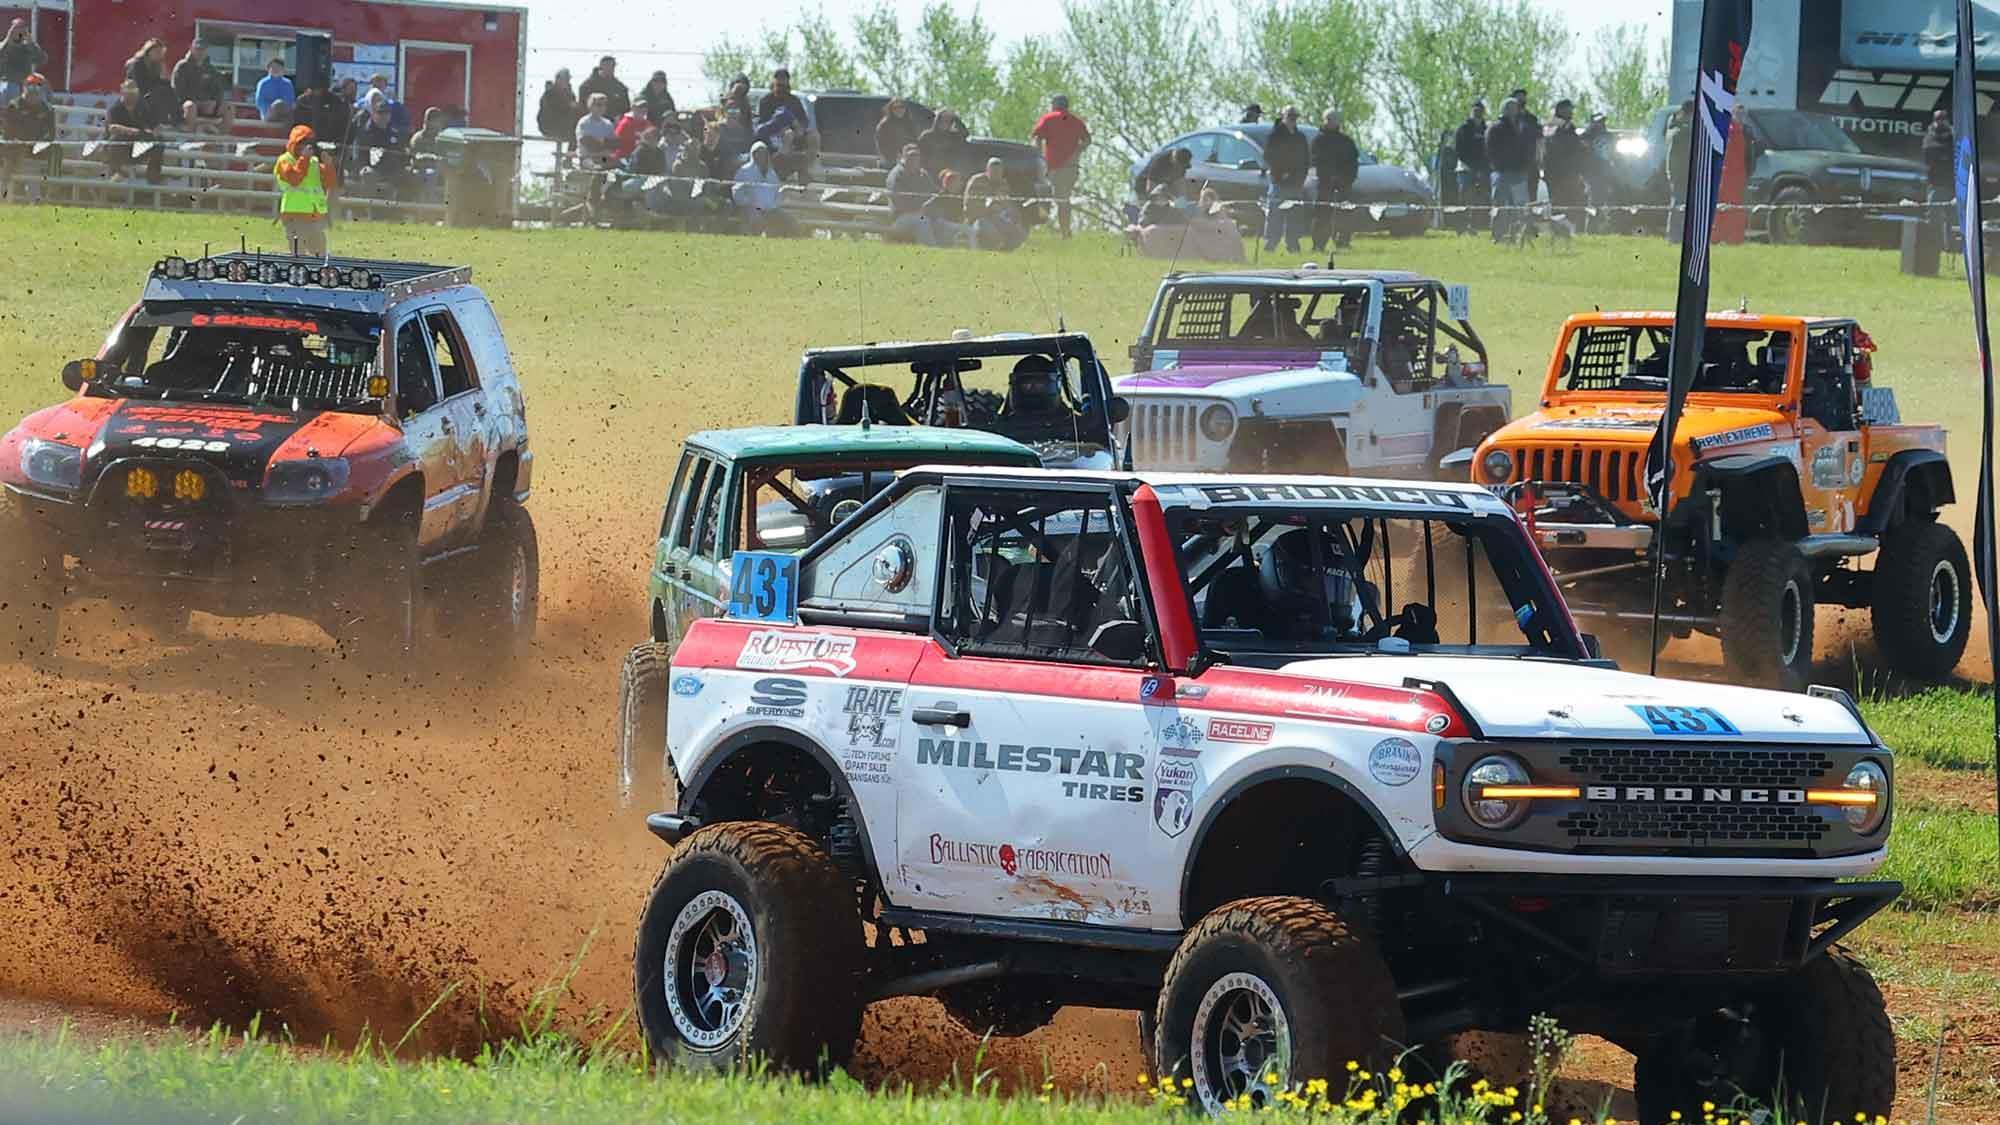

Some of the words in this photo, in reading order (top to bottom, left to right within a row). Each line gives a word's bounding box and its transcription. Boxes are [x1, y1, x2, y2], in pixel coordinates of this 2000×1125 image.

[213, 314, 318, 333] SHERPA
[1728, 425, 1772, 441] EXTREME
[1201, 485, 1468, 509] BRONCO
[735, 556, 796, 619] 431
[746, 706, 804, 718] SUPERWINCH
[842, 686, 904, 716] IRATE
[1646, 705, 1734, 733] 431
[1210, 722, 1273, 740] RACELINE
[916, 738, 1146, 780] MILESTAR
[1161, 765, 1194, 780] Yukon
[1062, 781, 1145, 803] TIRES
[1586, 786, 1806, 802] BRONCO
[929, 833, 1000, 866] BALLISTIC
[1016, 847, 1113, 879] FABRICATION
